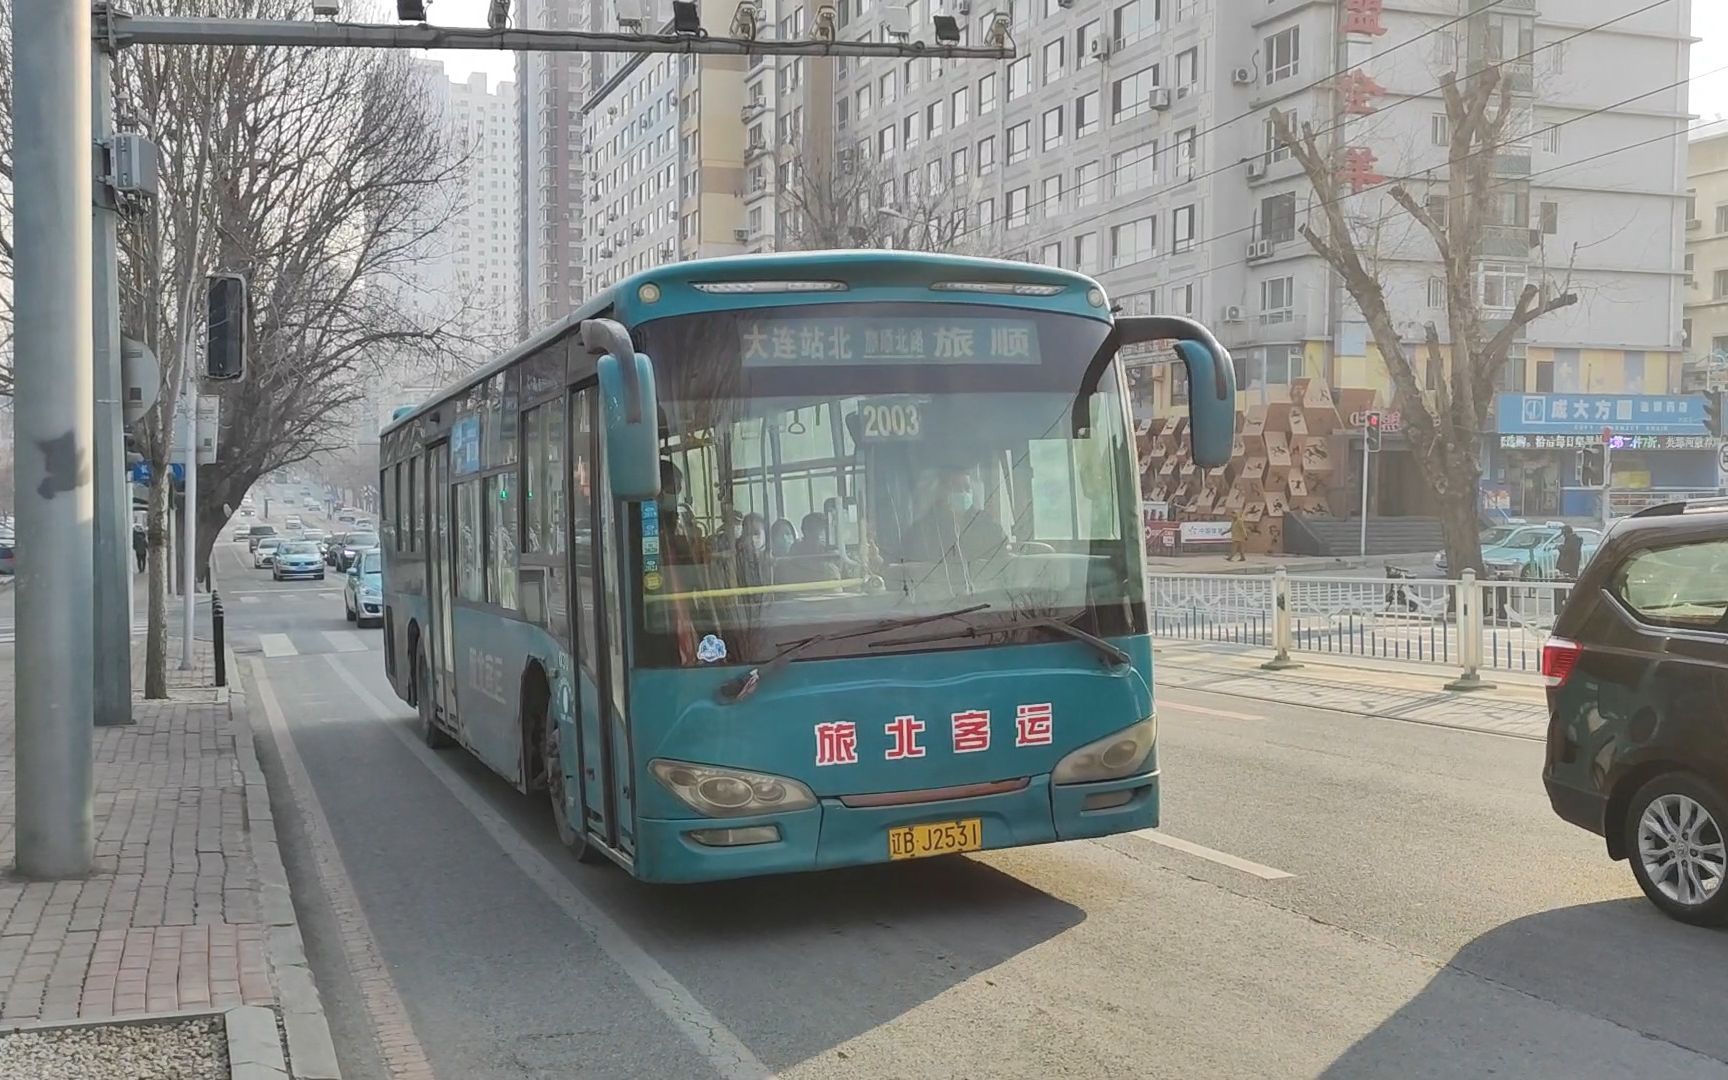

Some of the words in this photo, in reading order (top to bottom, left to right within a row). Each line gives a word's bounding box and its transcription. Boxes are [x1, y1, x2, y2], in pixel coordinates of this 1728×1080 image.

[743, 324, 853, 360] 大连站北
[933, 326, 1030, 358] 旅顺
[863, 404, 920, 437] 2003
[815, 702, 1054, 767] 旅北客运
